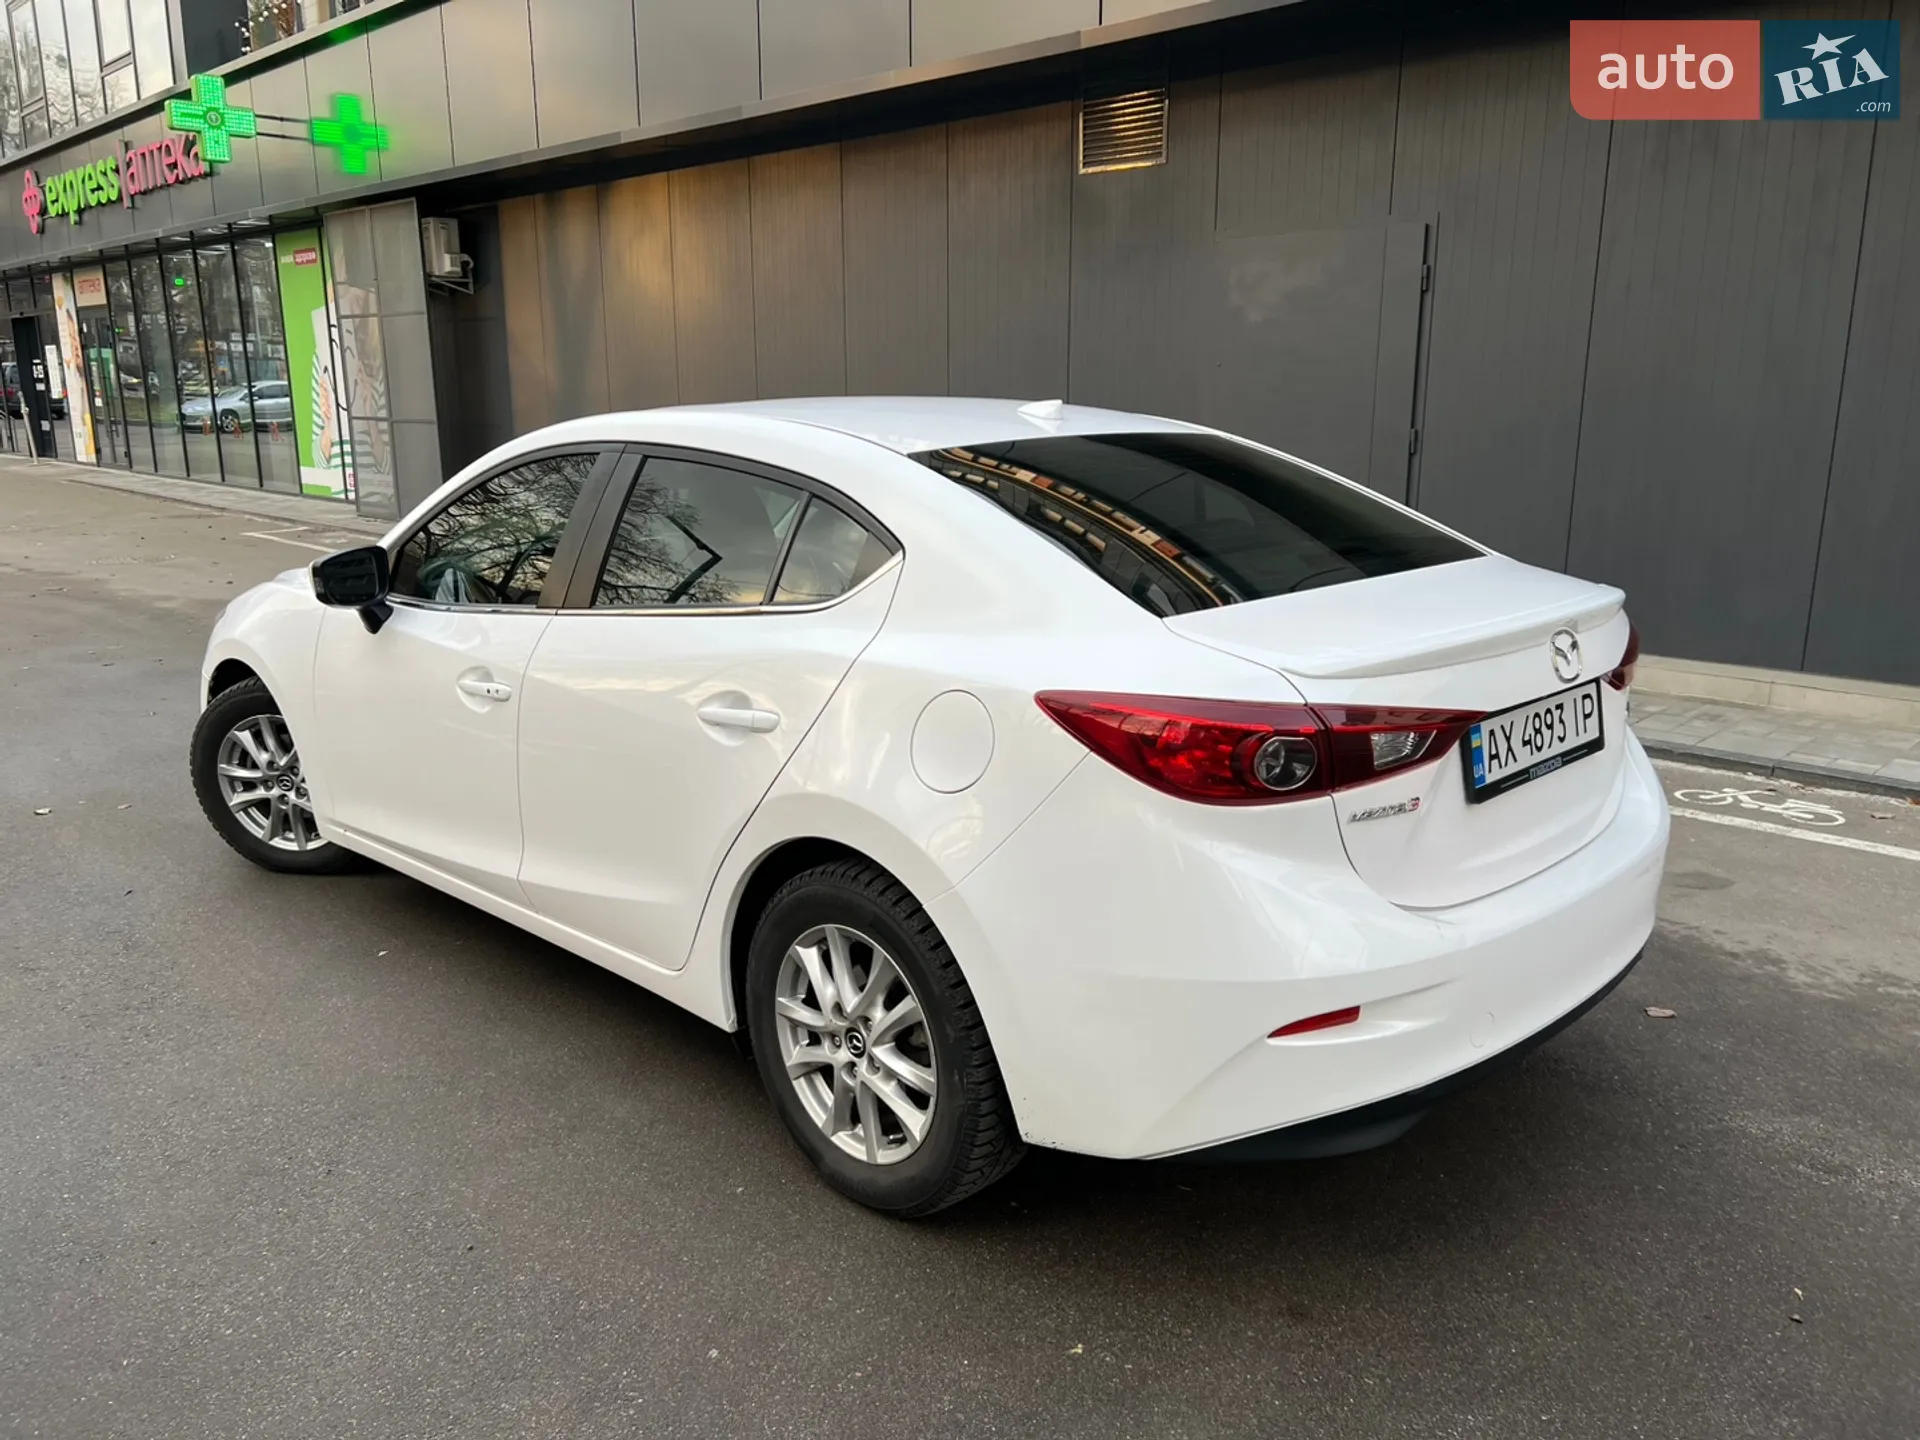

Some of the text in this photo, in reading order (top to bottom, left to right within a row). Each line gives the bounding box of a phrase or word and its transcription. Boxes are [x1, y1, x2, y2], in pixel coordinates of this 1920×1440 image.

[1488, 693, 1595, 774] AX 4893 IP
[1473, 763, 1484, 778] UA
